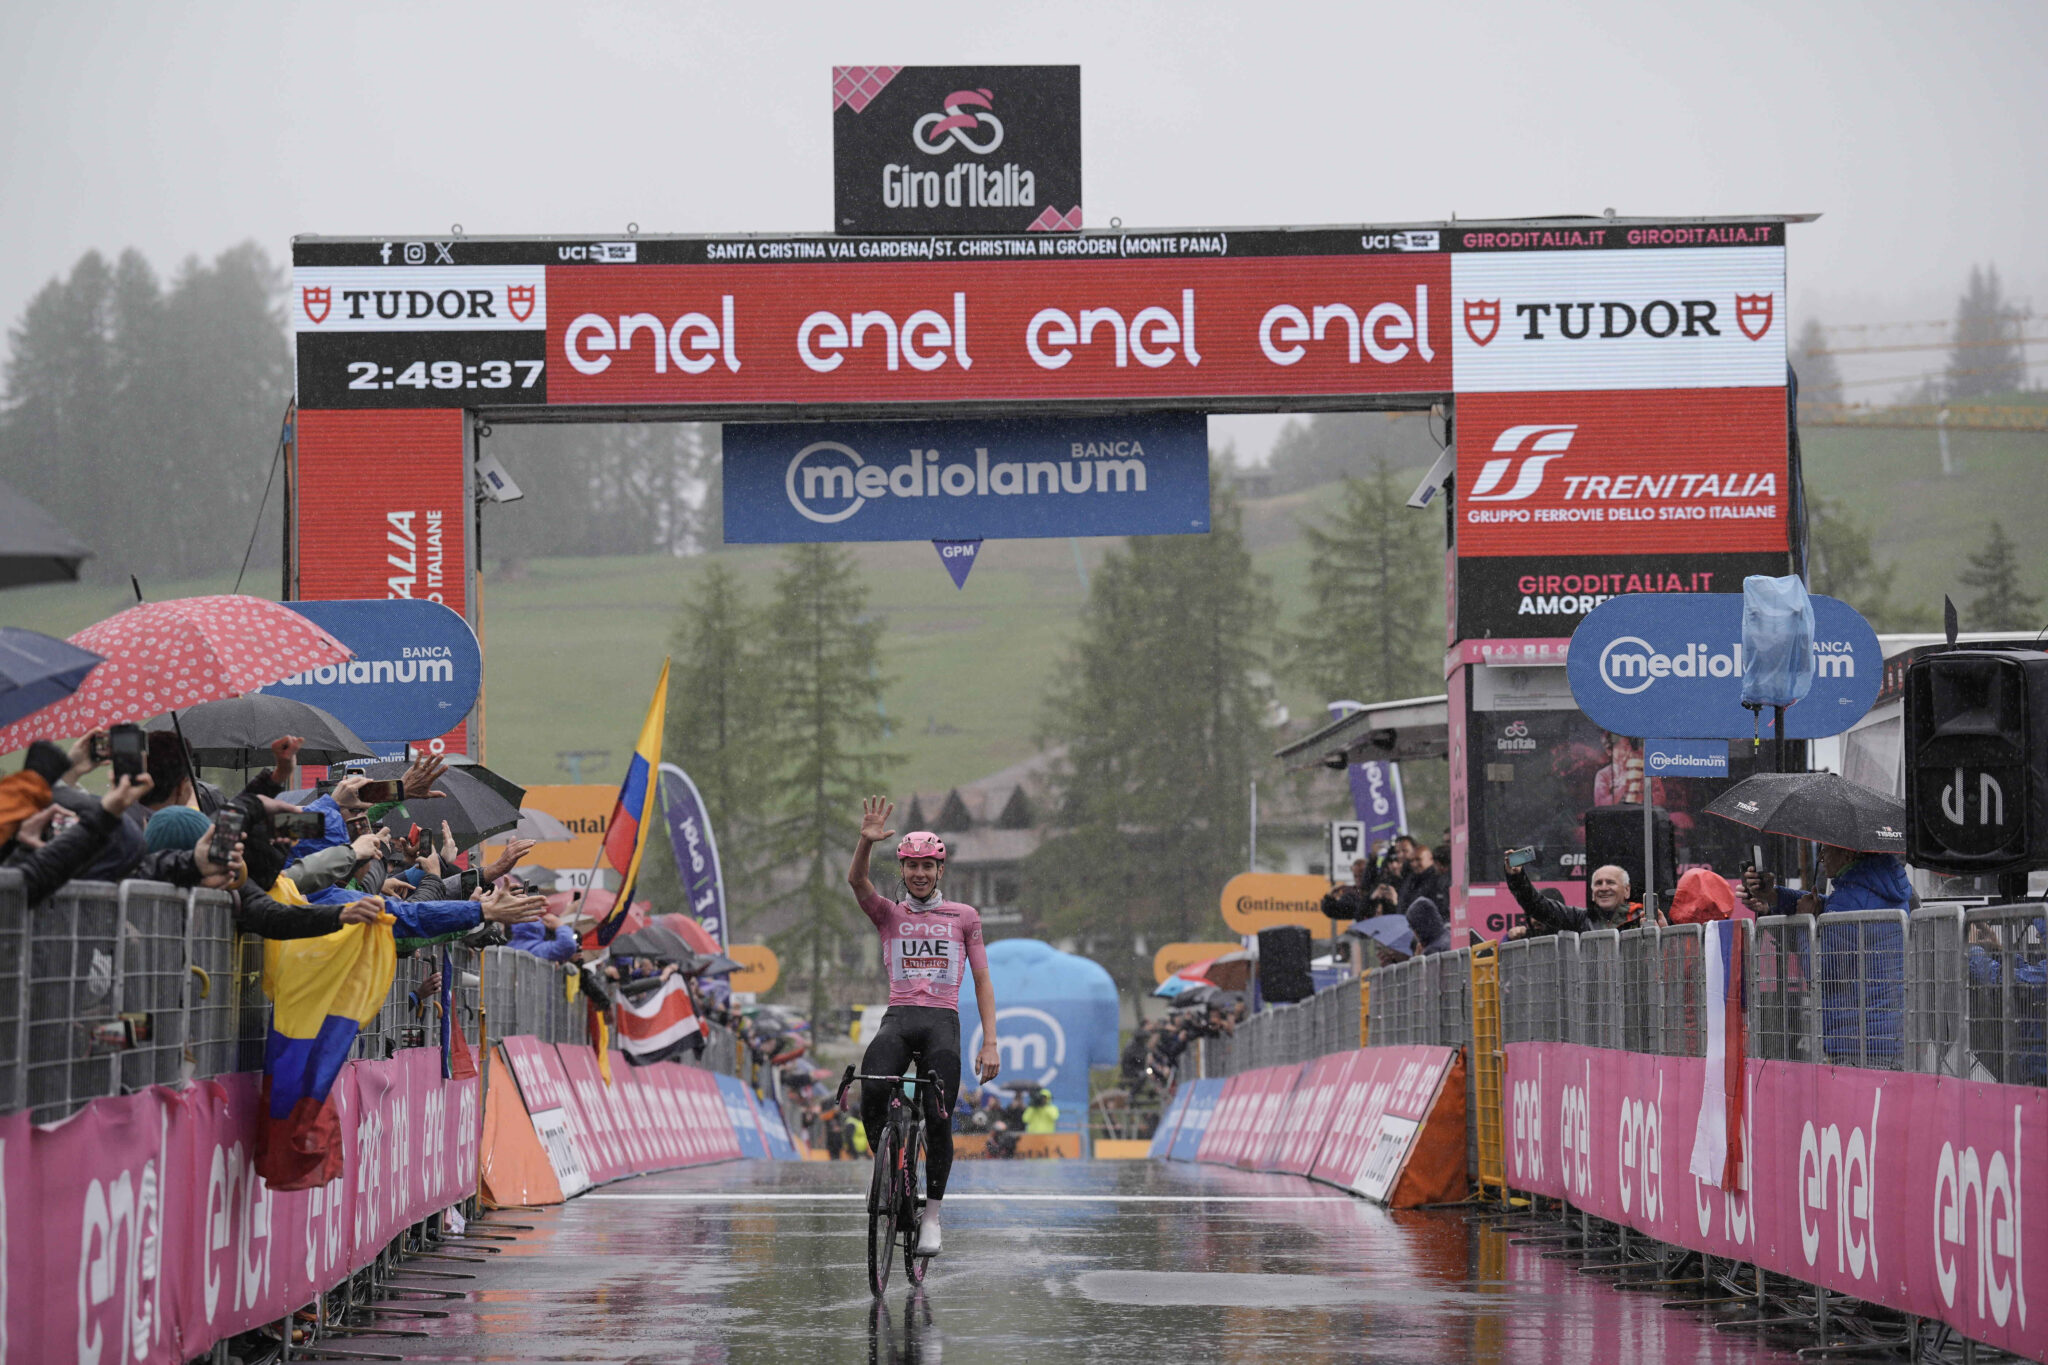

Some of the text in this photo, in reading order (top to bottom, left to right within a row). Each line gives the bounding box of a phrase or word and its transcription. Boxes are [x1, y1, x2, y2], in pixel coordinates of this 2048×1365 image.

[883, 162, 1035, 208] Giro d'Italia
[706, 233, 1228, 260] SANTA CRISTINA VAL GARDENA/ST. CHRISTINA IN GRÖDEN (MONTE PANA)
[1362, 235, 1389, 249] UCI
[1462, 226, 1771, 248] GIRODITALIA.IT GIRODITALIA.IT
[558, 246, 587, 260] UCI
[343, 288, 496, 320] TUDOR
[564, 284, 1436, 375] enel enel enel enel
[1516, 300, 1721, 341] TUDOR
[347, 359, 546, 391] 2:49:37
[1071, 441, 1145, 458] BANCA
[802, 447, 1147, 498] mediolanum
[1562, 472, 1777, 500] TRENITALIA
[1467, 505, 1776, 524] GRUPPO FERROVIE DELLO STATO ITALIANE
[387, 511, 416, 600] ALIA
[426, 510, 443, 587] ITALIANE
[942, 544, 975, 558] GPM
[1517, 572, 1714, 594] GIRODITALIA.IT
[1517, 594, 1617, 615] AMOR
[402, 647, 452, 658] BANCA
[1812, 641, 1853, 653] ANCA
[1611, 643, 1856, 678] mediolm
[1653, 754, 1726, 767] mediolanum
[569, 872, 587, 887] 10
[1236, 895, 1321, 915] Continenta
[898, 922, 953, 938] enel
[902, 940, 949, 956] UAE
[903, 958, 949, 969] Emirates
[391, 1061, 410, 1225] enel
[422, 1078, 449, 1203] enel
[1513, 1053, 1544, 1181] enel
[1560, 1058, 1592, 1198] enel
[1618, 1068, 1664, 1223] enel
[1695, 1074, 1756, 1246] el
[1799, 1087, 1881, 1283] enel
[1933, 1104, 2026, 1331] enel
